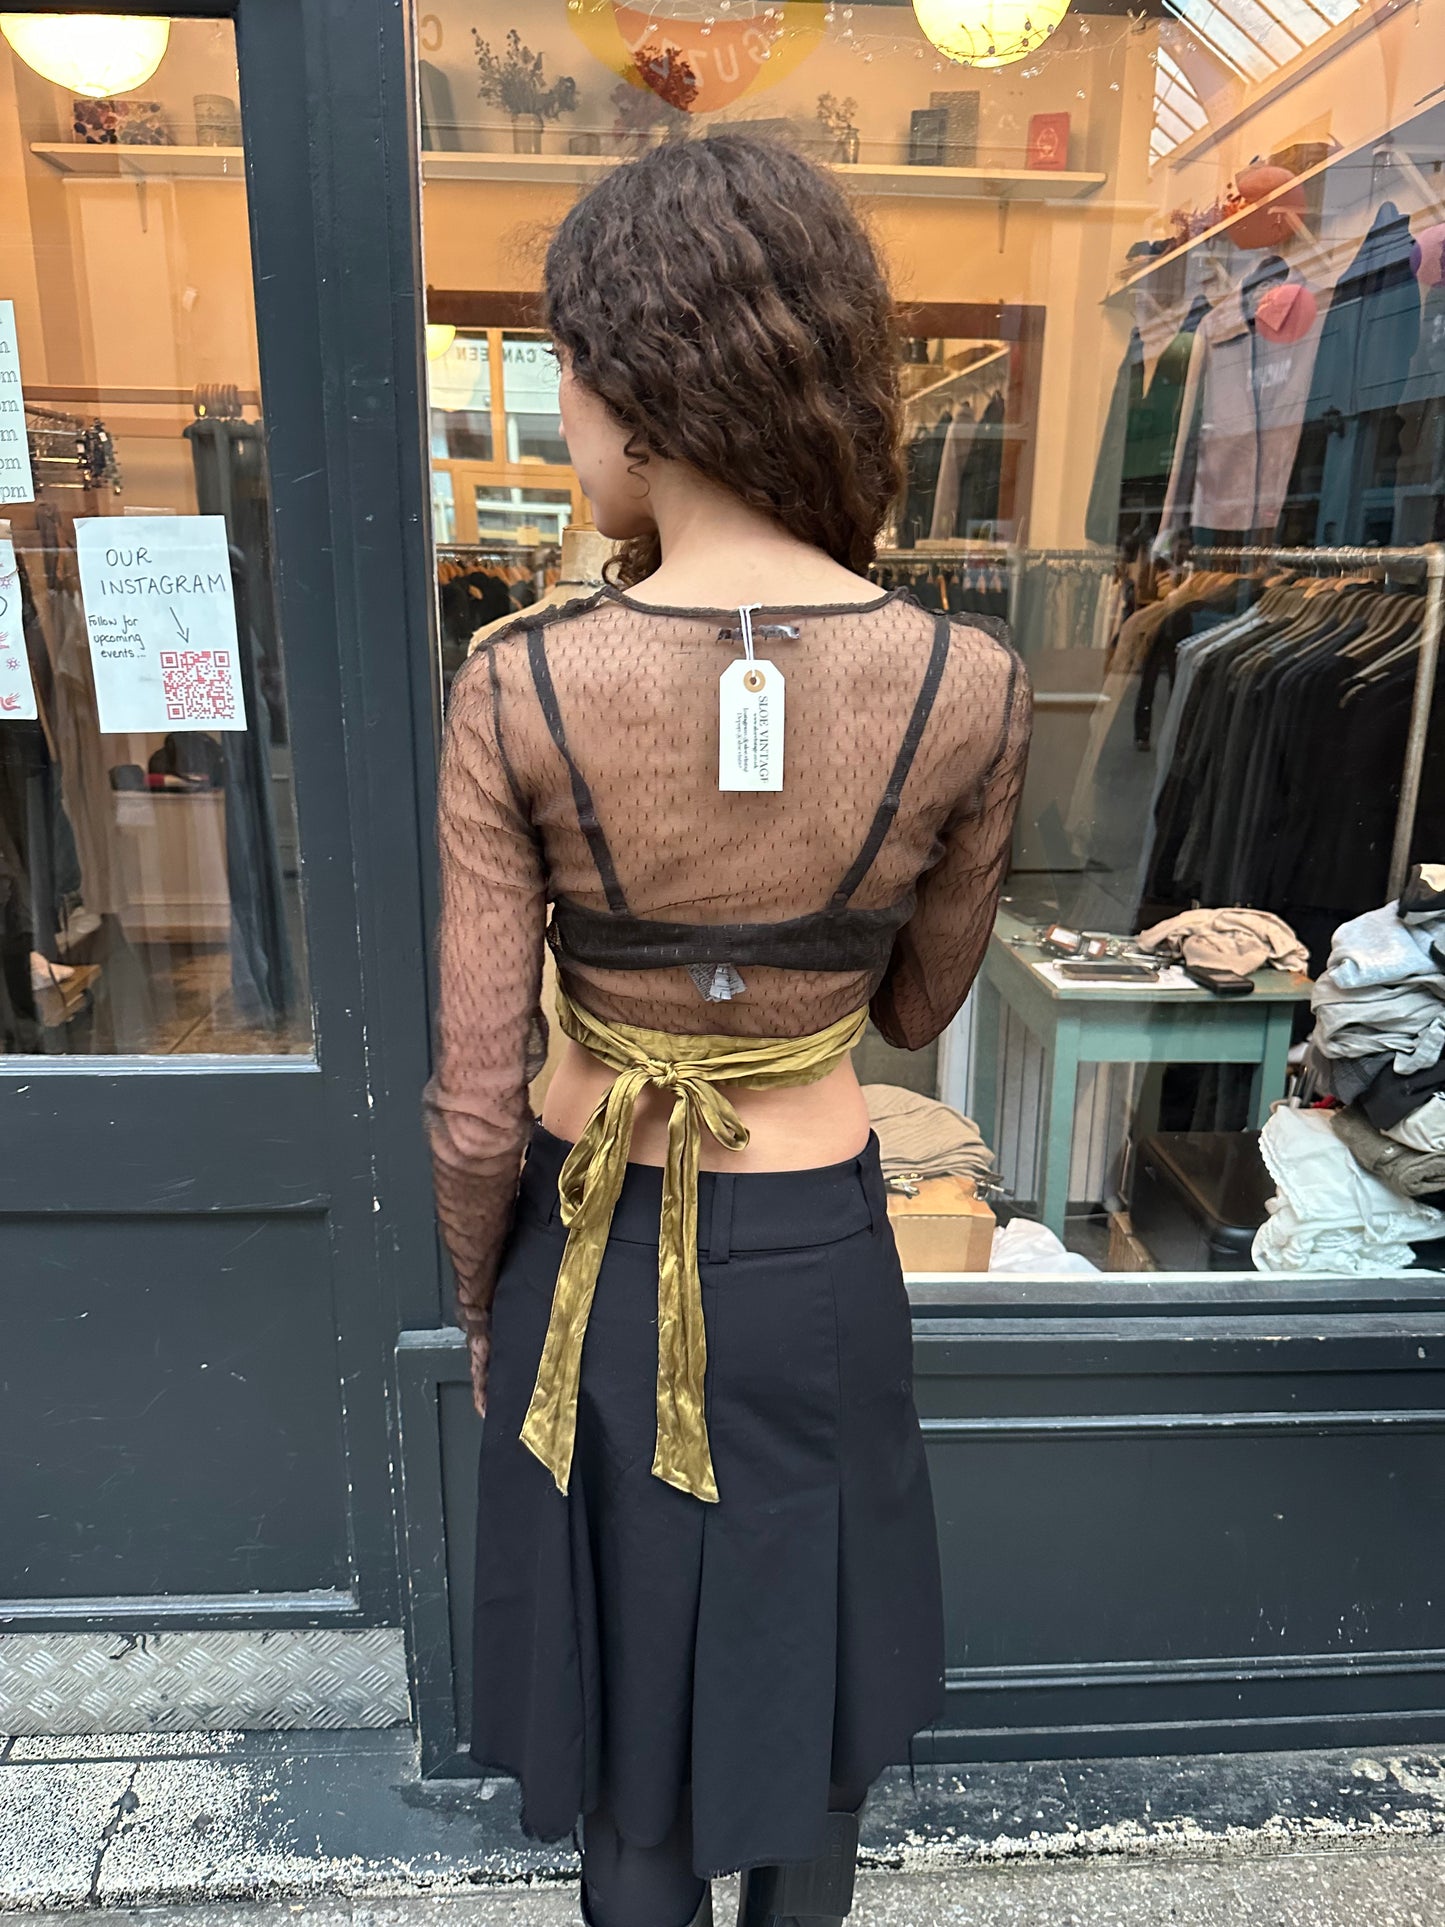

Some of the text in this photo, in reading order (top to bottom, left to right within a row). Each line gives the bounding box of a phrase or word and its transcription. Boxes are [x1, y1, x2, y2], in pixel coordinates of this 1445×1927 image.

[0, 371, 18, 383] m
[0, 400, 20, 412] m
[0, 429, 19, 441] m
[105, 547, 153, 567] OUR
[100, 573, 227, 596] INSTAGRAM
[88, 614, 139, 635] Follow for
[93, 633, 146, 651] upcoming
[759, 695, 769, 727] SLOE
